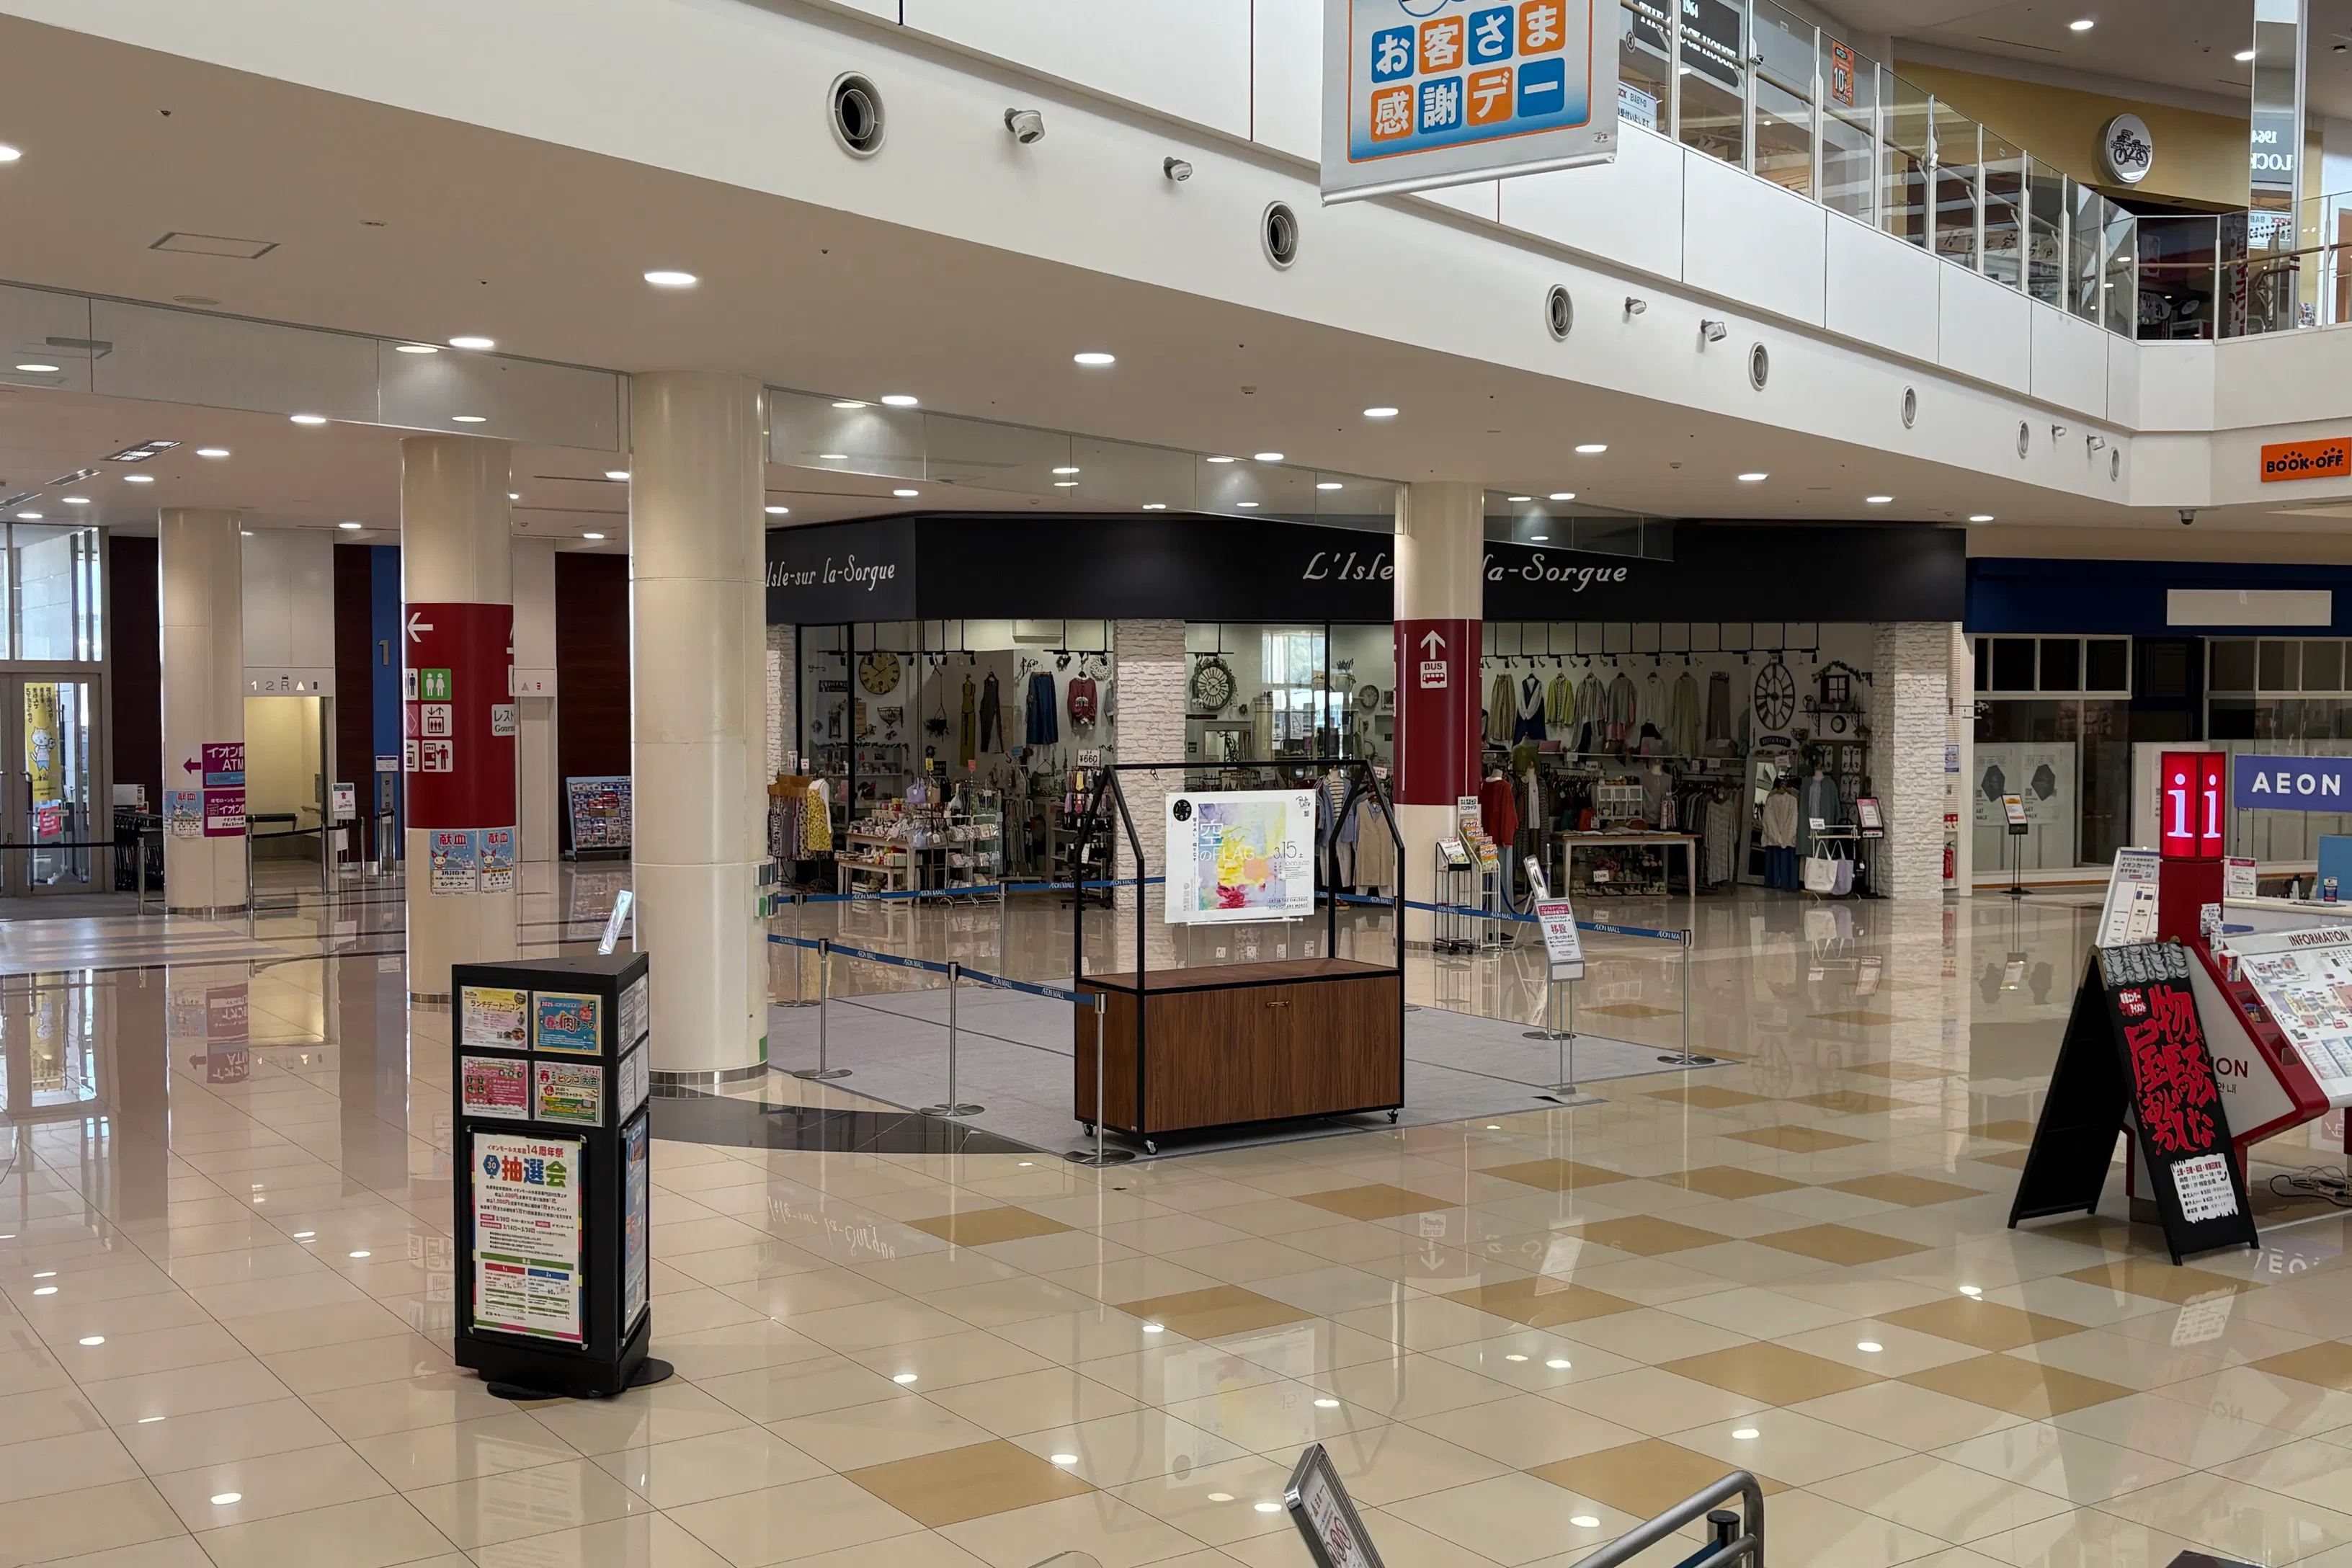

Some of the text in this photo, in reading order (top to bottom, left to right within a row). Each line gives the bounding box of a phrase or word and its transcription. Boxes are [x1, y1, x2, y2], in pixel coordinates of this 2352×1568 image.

[1376, 5, 1557, 75] お客さま
[1376, 71, 1559, 135] 感謝デー
[766, 554, 895, 591] Isle-sur la-Sorgue
[1483, 553, 1627, 592] la-Sorgue
[378, 640, 389, 666] 1
[251, 680, 257, 691] 1
[266, 681, 274, 691] 2
[1079, 754, 1097, 763] ¥660
[2251, 772, 2341, 796] AEON
[440, 834, 466, 845] 献血
[1200, 819, 1224, 847] 空
[1273, 841, 1297, 859] 3.15
[502, 1155, 567, 1188] 抽選会
